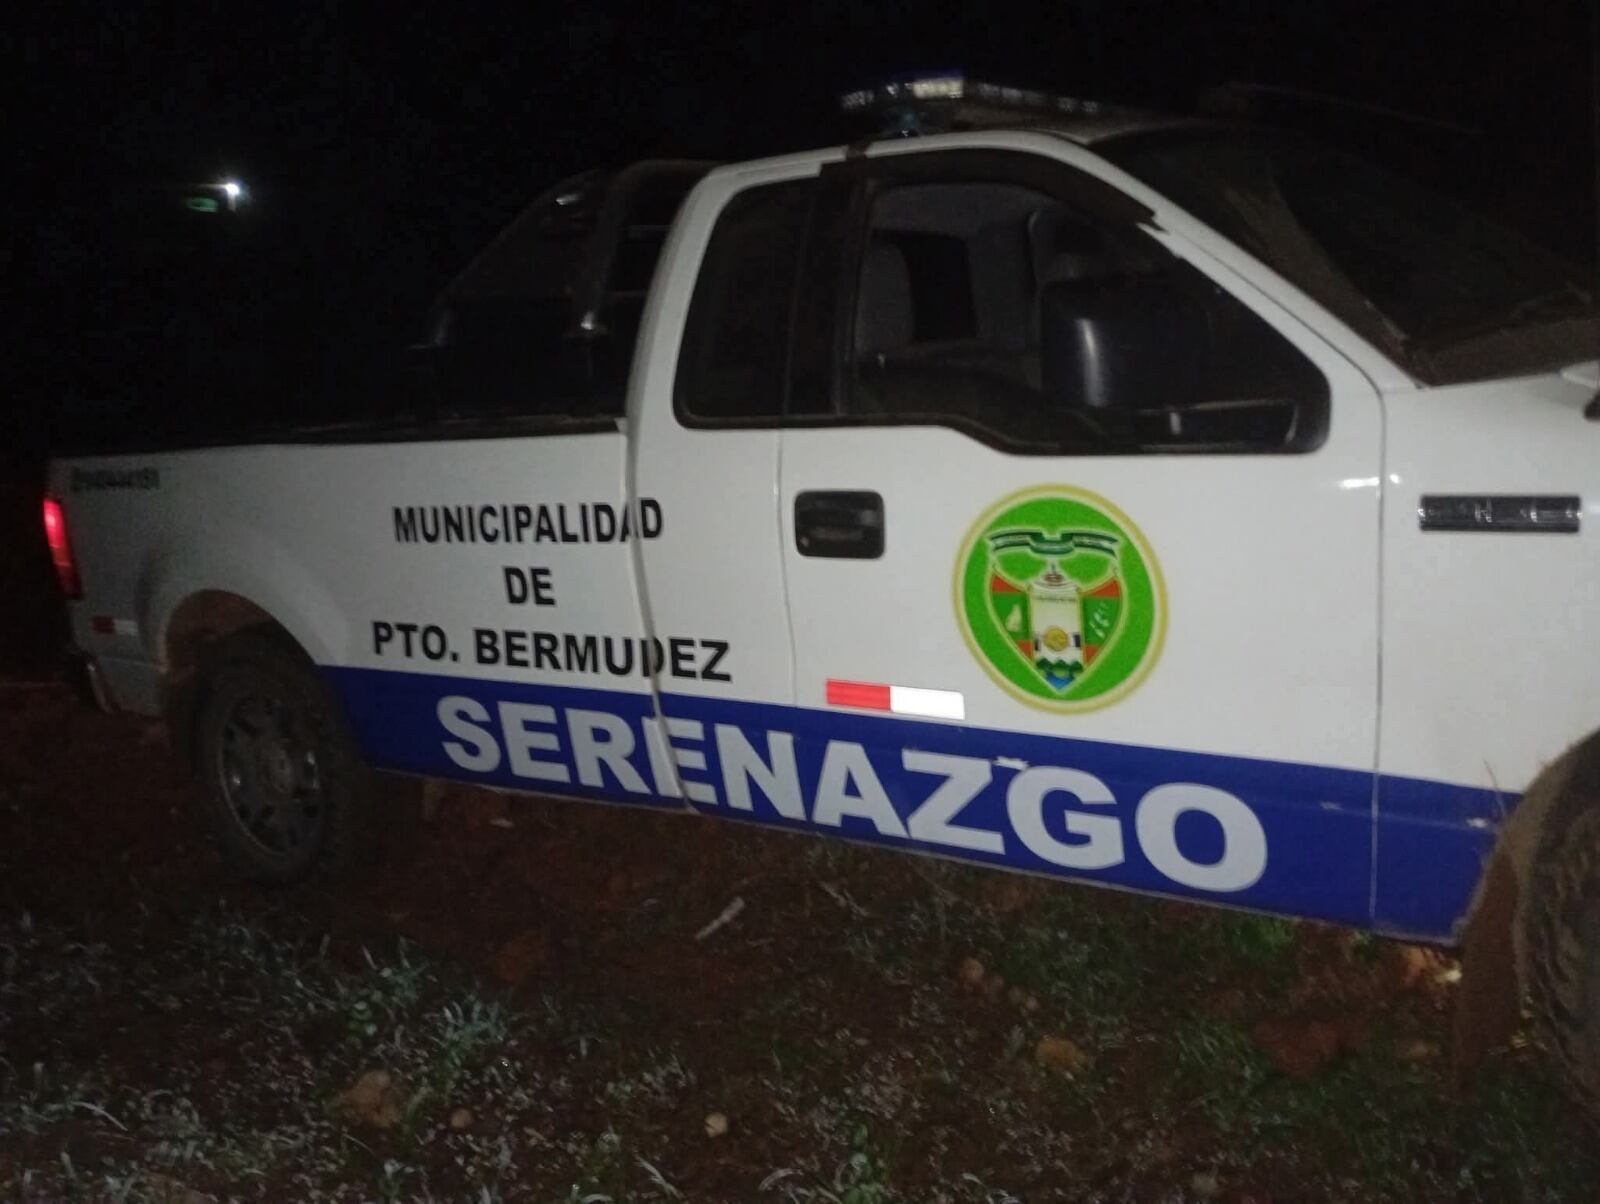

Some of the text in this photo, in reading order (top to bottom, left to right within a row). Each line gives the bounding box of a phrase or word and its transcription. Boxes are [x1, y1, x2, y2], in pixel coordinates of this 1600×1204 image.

[504, 566, 556, 606] DE
[372, 620, 732, 682] PTO. BERMUDEZ
[435, 694, 1267, 893] SERENAZGO
